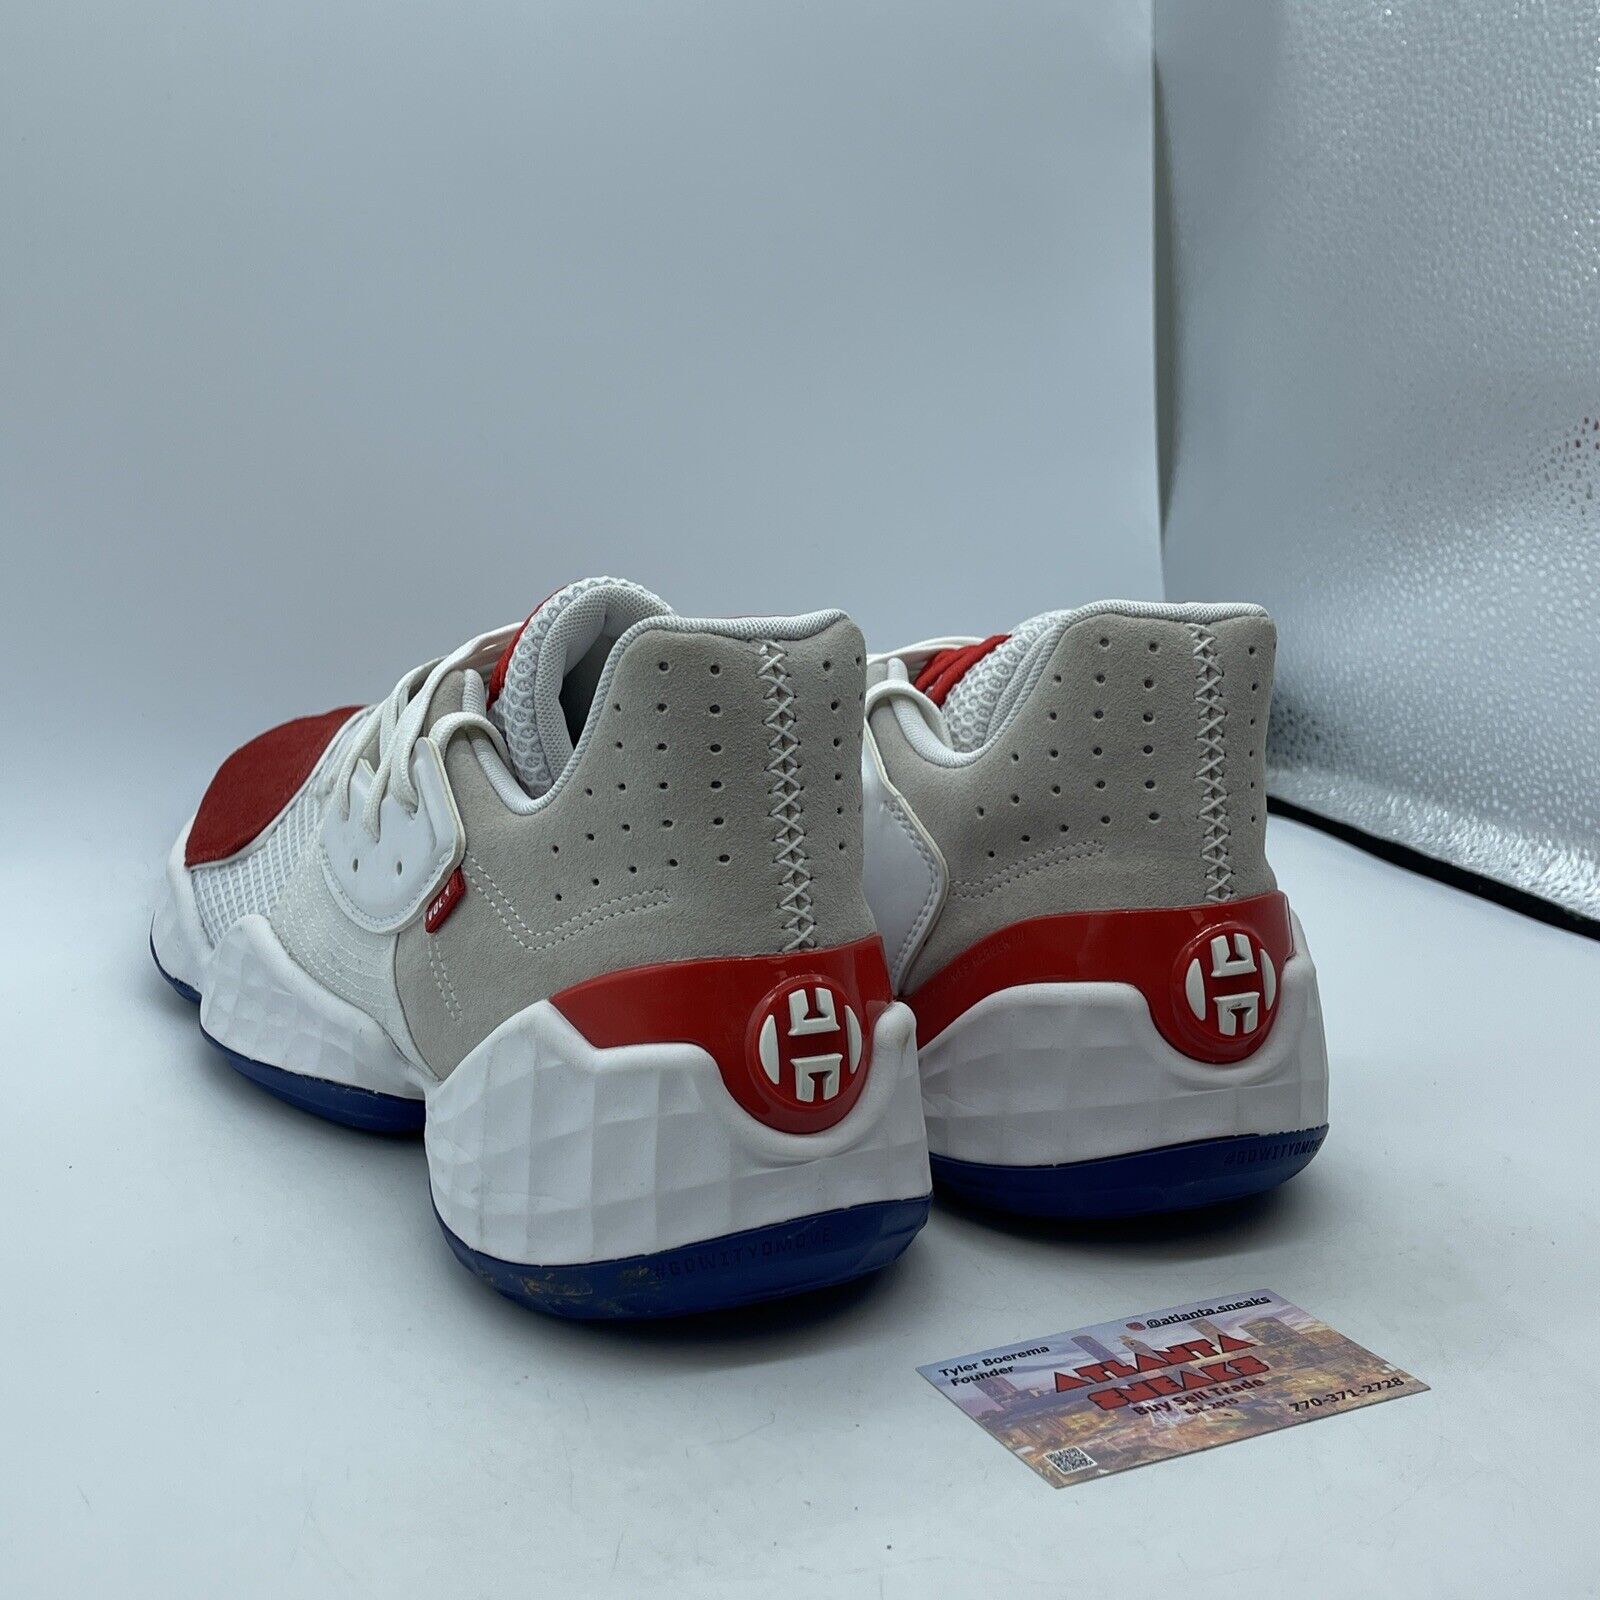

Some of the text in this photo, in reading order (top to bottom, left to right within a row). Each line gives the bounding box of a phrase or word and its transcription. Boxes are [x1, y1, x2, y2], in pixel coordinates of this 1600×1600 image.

[1146, 1296, 1272, 1329] @atlanta.sneaks
[938, 1345, 1051, 1377] Tyler Boerema
[950, 1364, 1015, 1386] Founder
[1054, 1334, 1257, 1393] ATLANTA
[1087, 1355, 1270, 1411] SNEAKS
[1131, 1379, 1266, 1416] Buy Sell Trade
[1289, 1377, 1404, 1412] 770-371-2728
